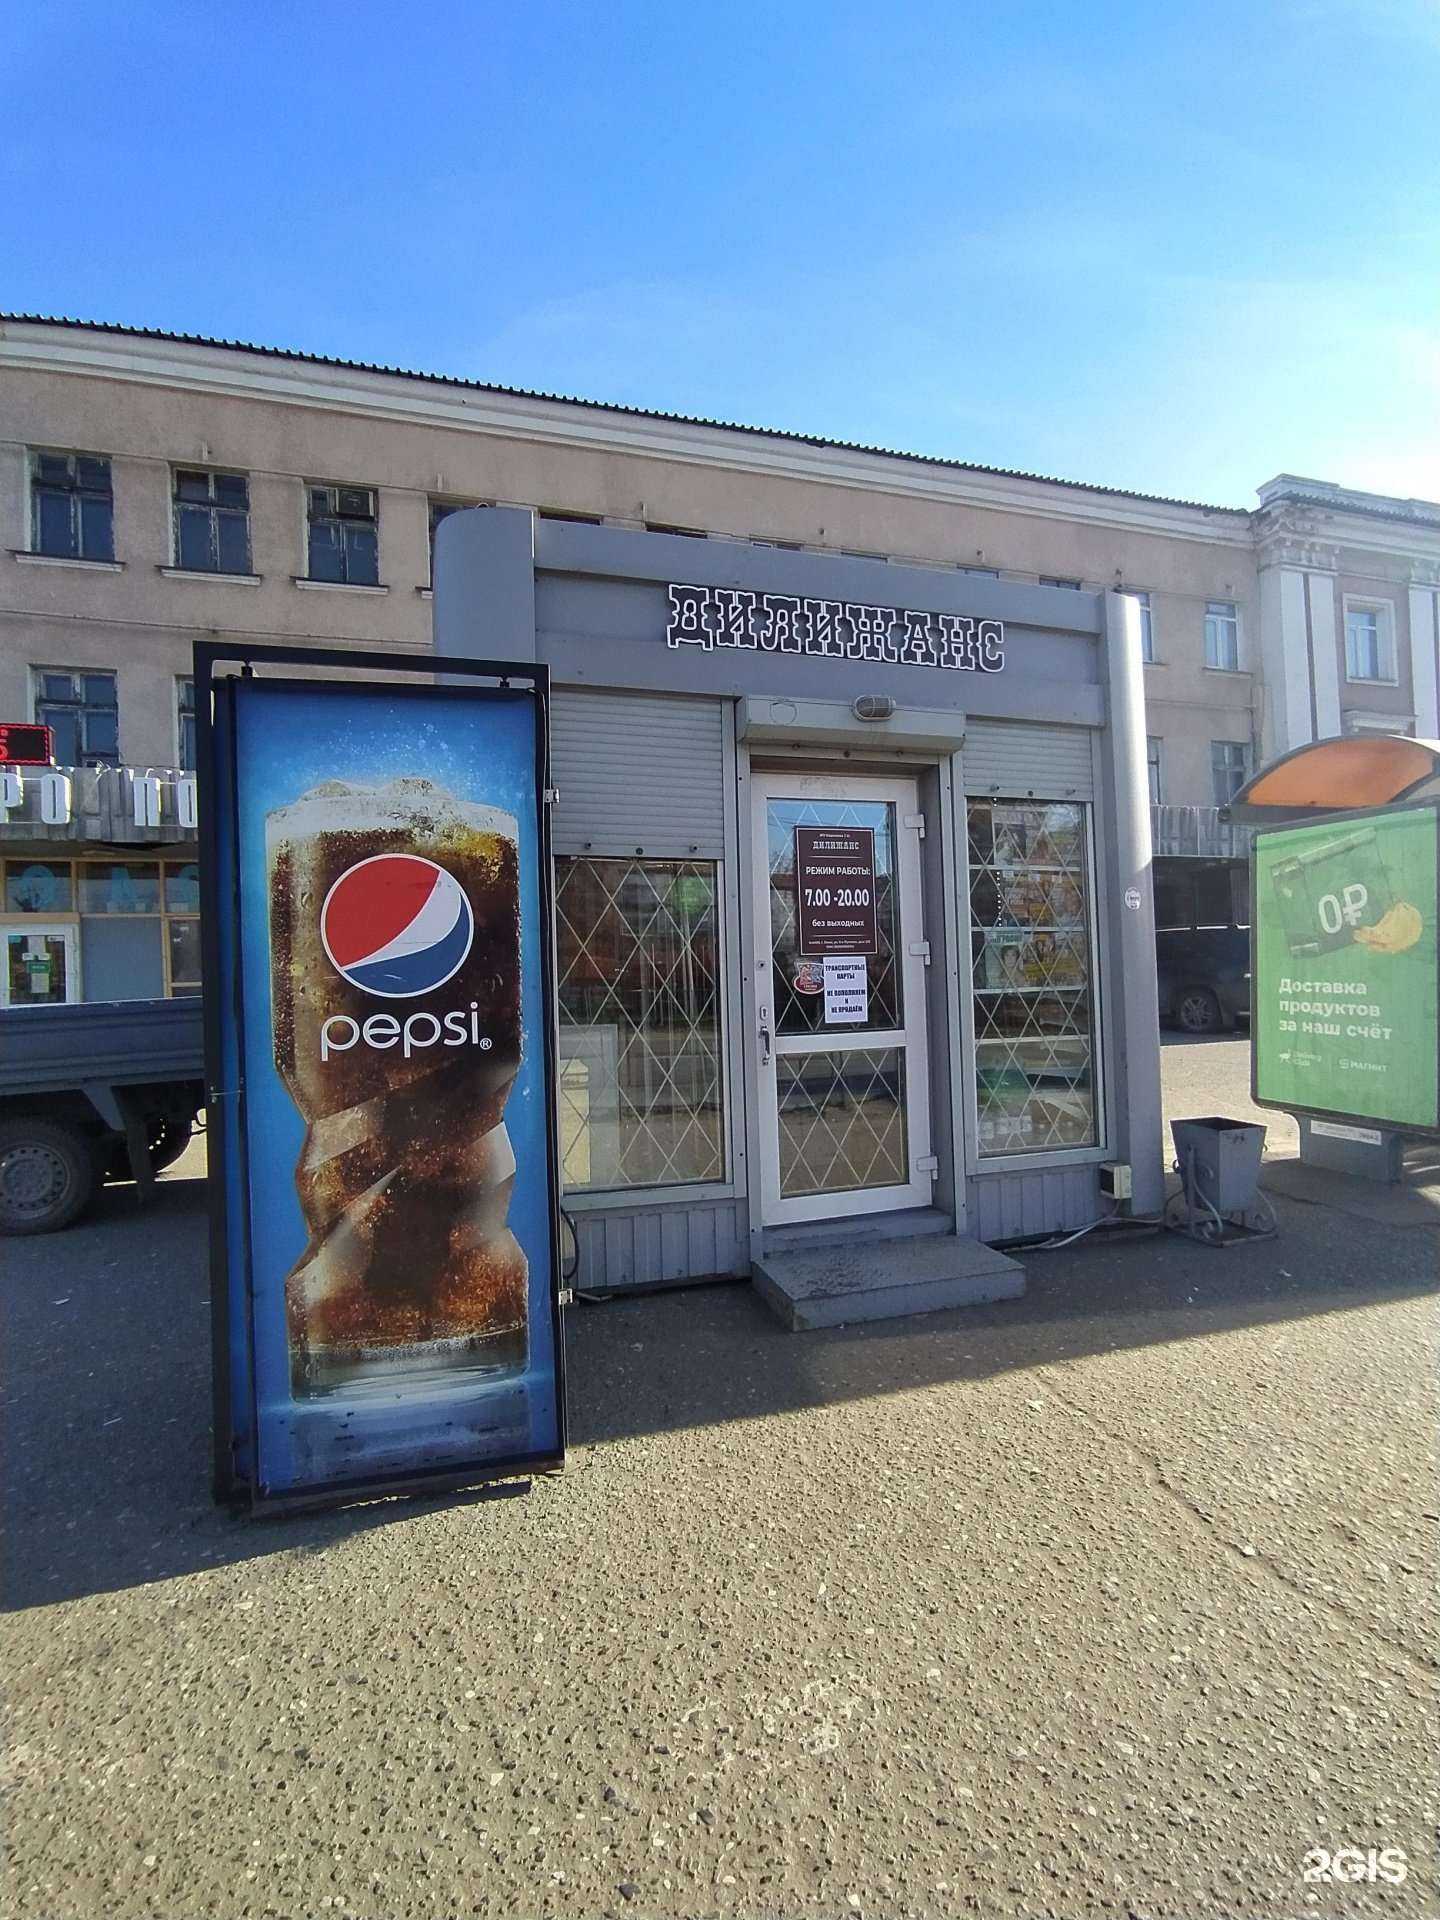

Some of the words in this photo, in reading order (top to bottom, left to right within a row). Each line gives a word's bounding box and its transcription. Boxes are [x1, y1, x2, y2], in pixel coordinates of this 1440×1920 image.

[667, 583, 1005, 672] ДИЛИЖАНС
[805, 866, 836, 876] РЕЖИМ
[836, 866, 872, 876] РАБОТЫ:
[805, 888, 831, 907] 7.00
[812, 919, 826, 928] без
[826, 920, 865, 929] выходных
[1279, 978, 1367, 995] Доставка
[1279, 1000, 1381, 1017] продуктов
[321, 1001, 479, 1062] pepsi
[1279, 1020, 1297, 1032] за
[1302, 1022, 1341, 1035] наш
[1346, 1023, 1393, 1040] счёт
